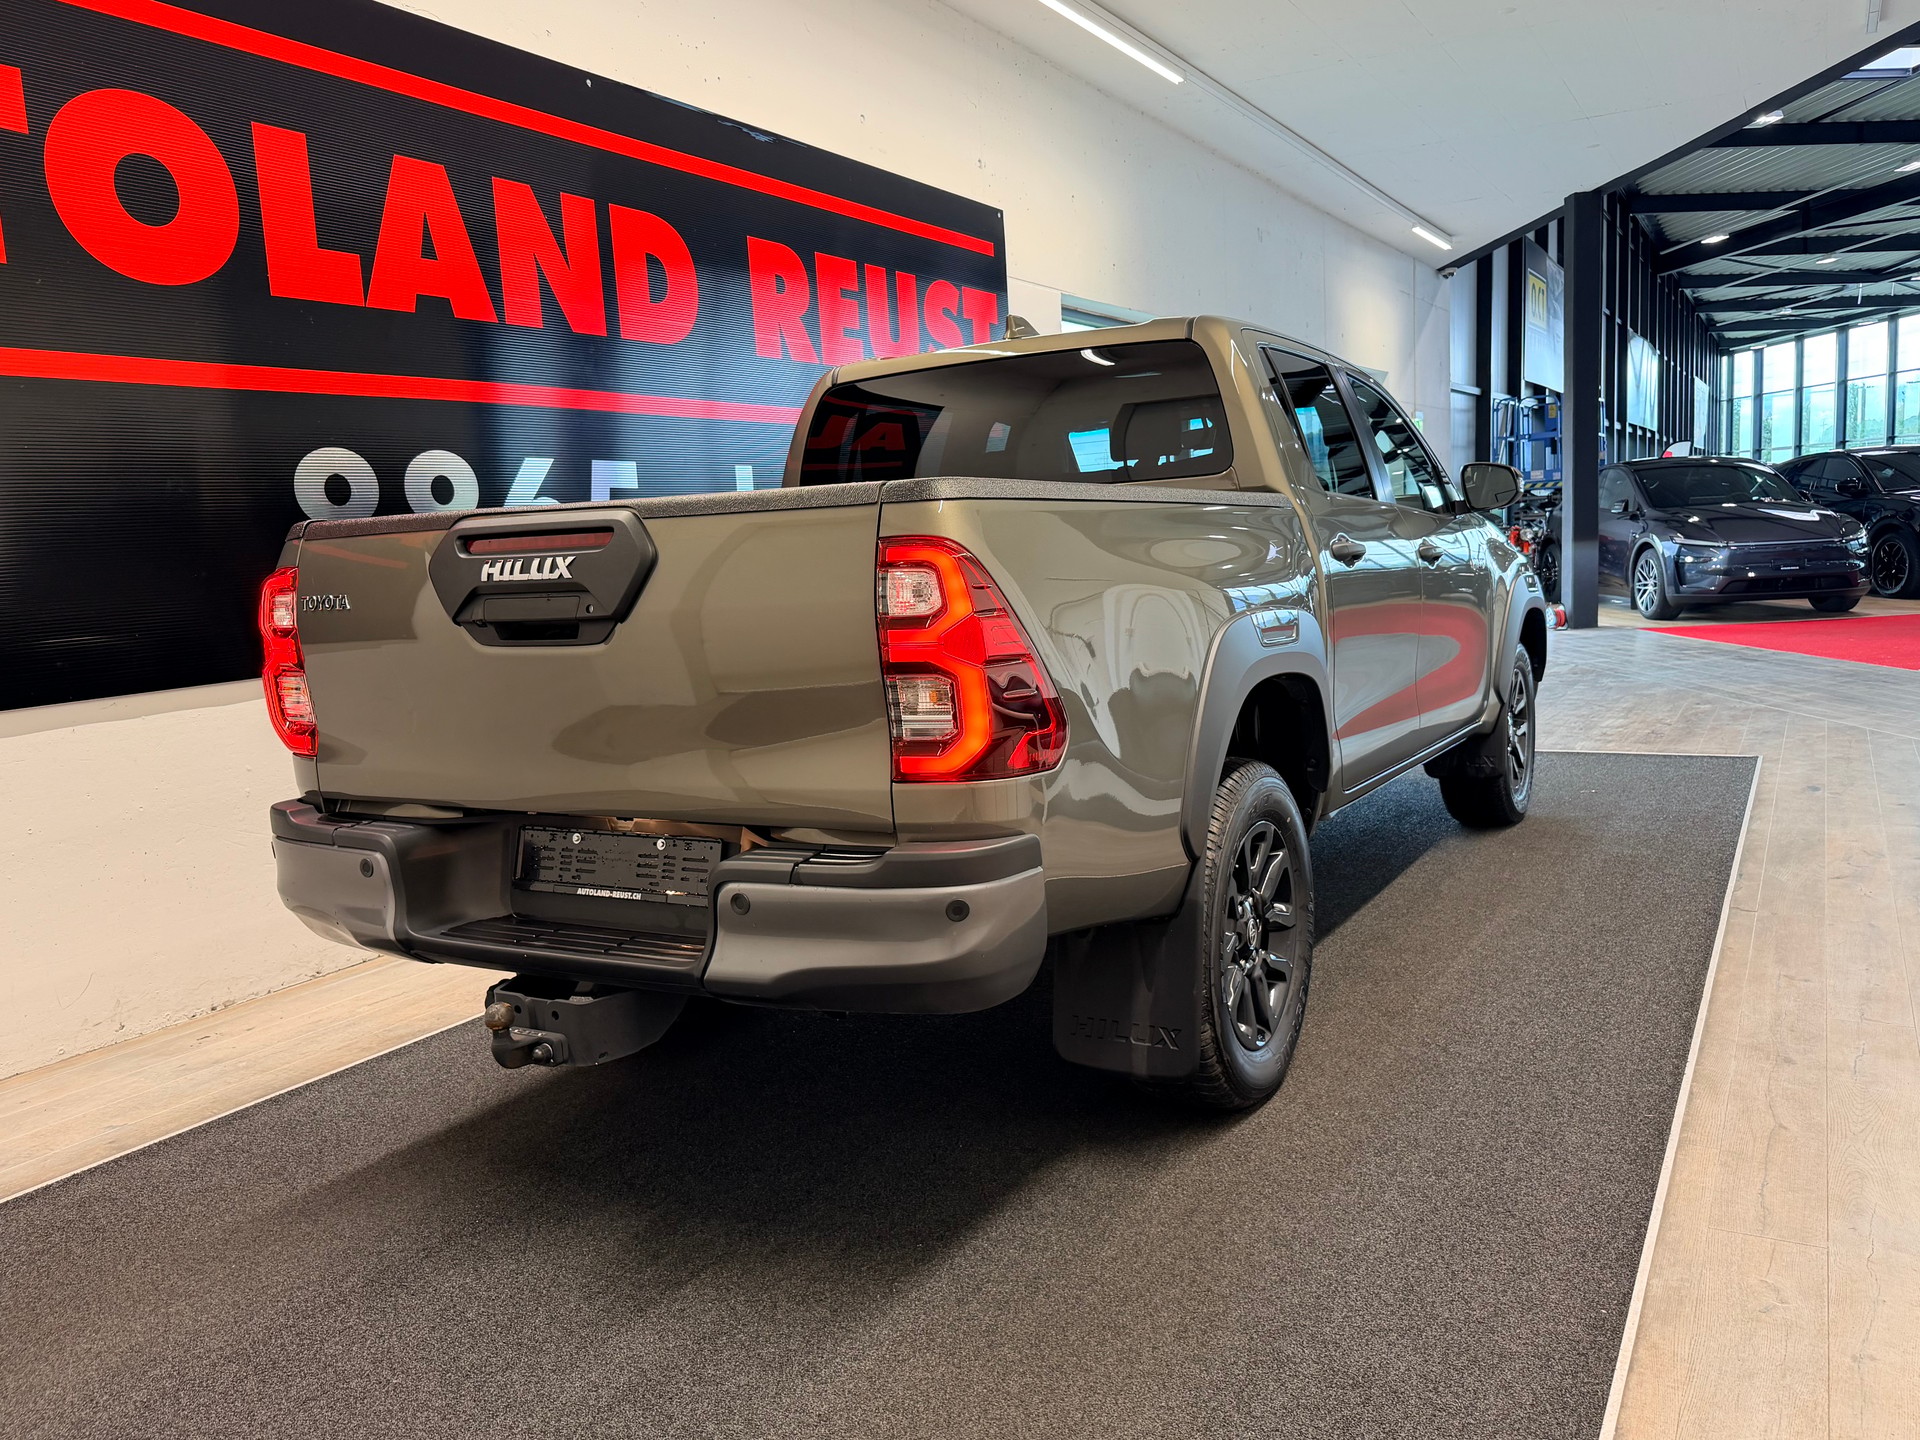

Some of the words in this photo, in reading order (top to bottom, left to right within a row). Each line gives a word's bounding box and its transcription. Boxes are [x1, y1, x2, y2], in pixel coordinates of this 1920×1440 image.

[747, 235, 998, 367] REUST
[481, 556, 576, 582] HILUX
[301, 594, 351, 611] TOYOTA
[576, 887, 642, 900] AUTOLAND-REUST.CH
[1070, 1015, 1182, 1050] HILUX
